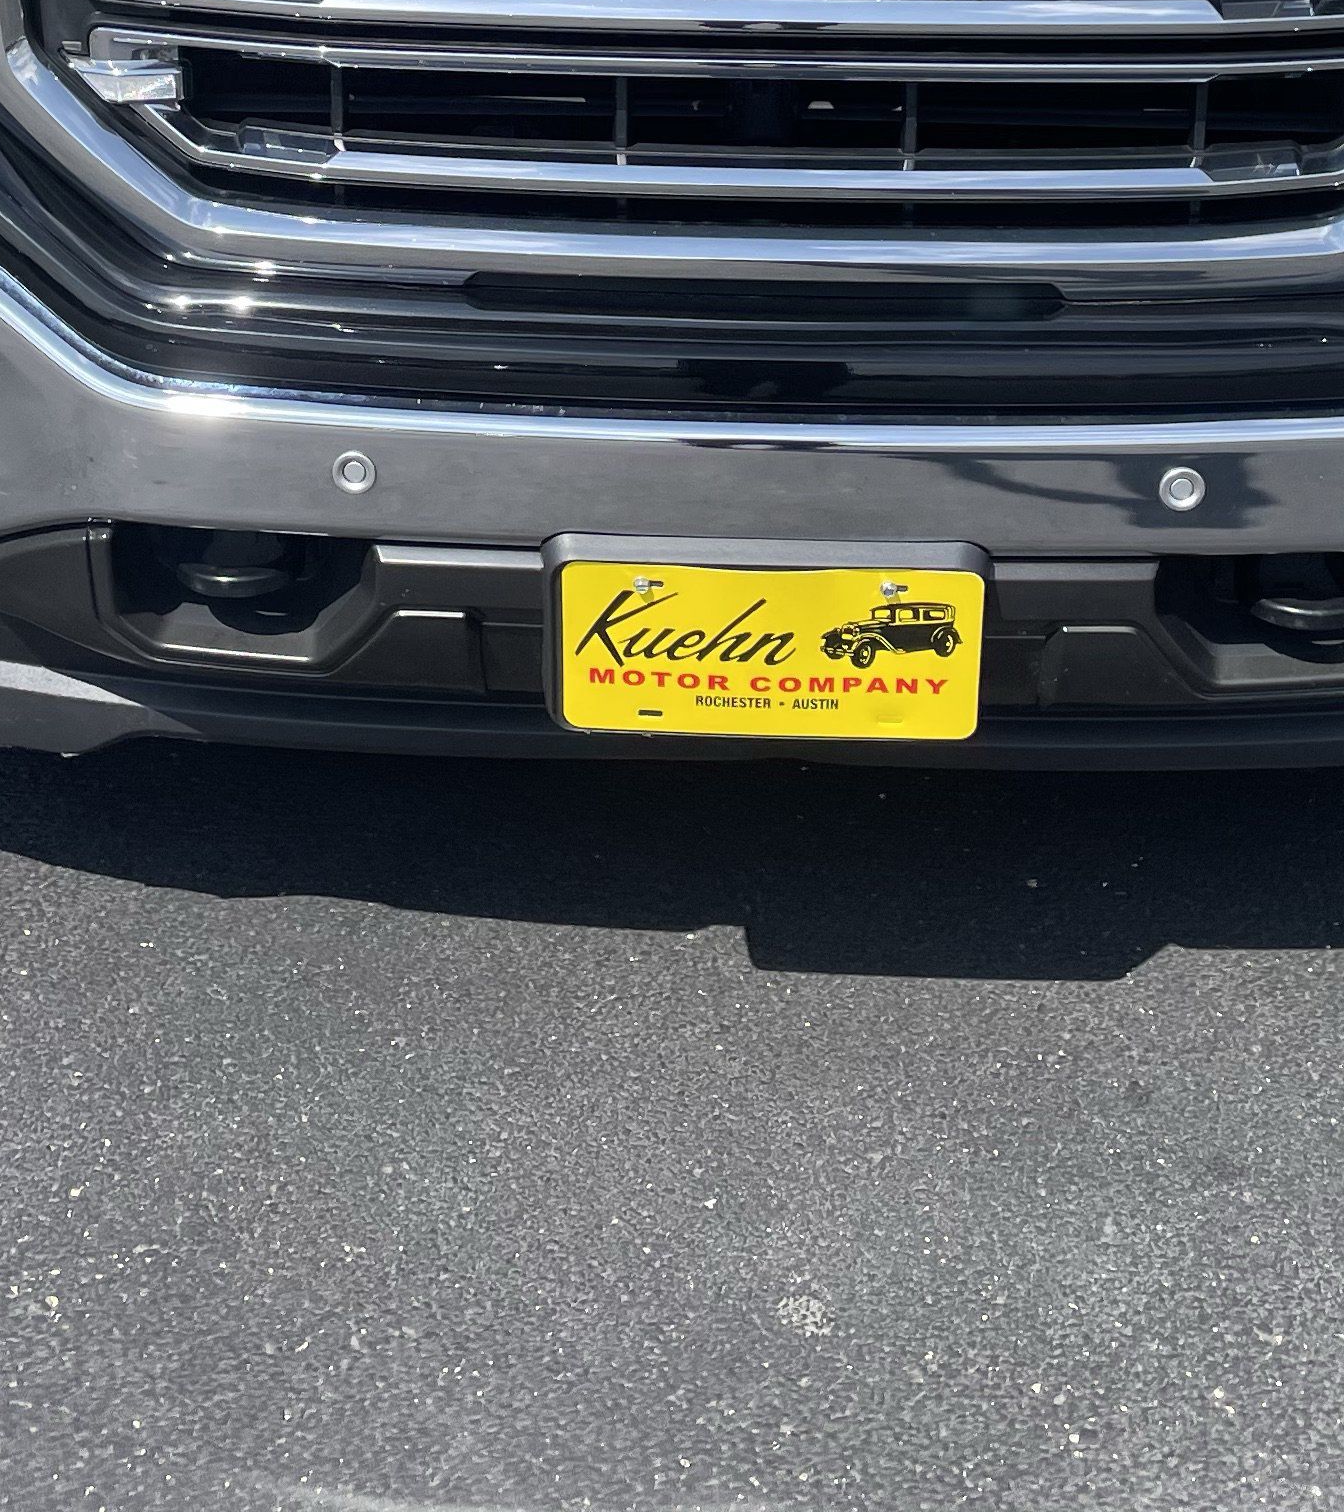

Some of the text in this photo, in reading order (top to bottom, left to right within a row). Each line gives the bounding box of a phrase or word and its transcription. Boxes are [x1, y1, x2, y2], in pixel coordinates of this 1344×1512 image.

[574, 588, 798, 668] Kuehn
[588, 666, 951, 696] MOTOR COMPANY
[694, 694, 840, 711] ROCHESTER AUSTIN
